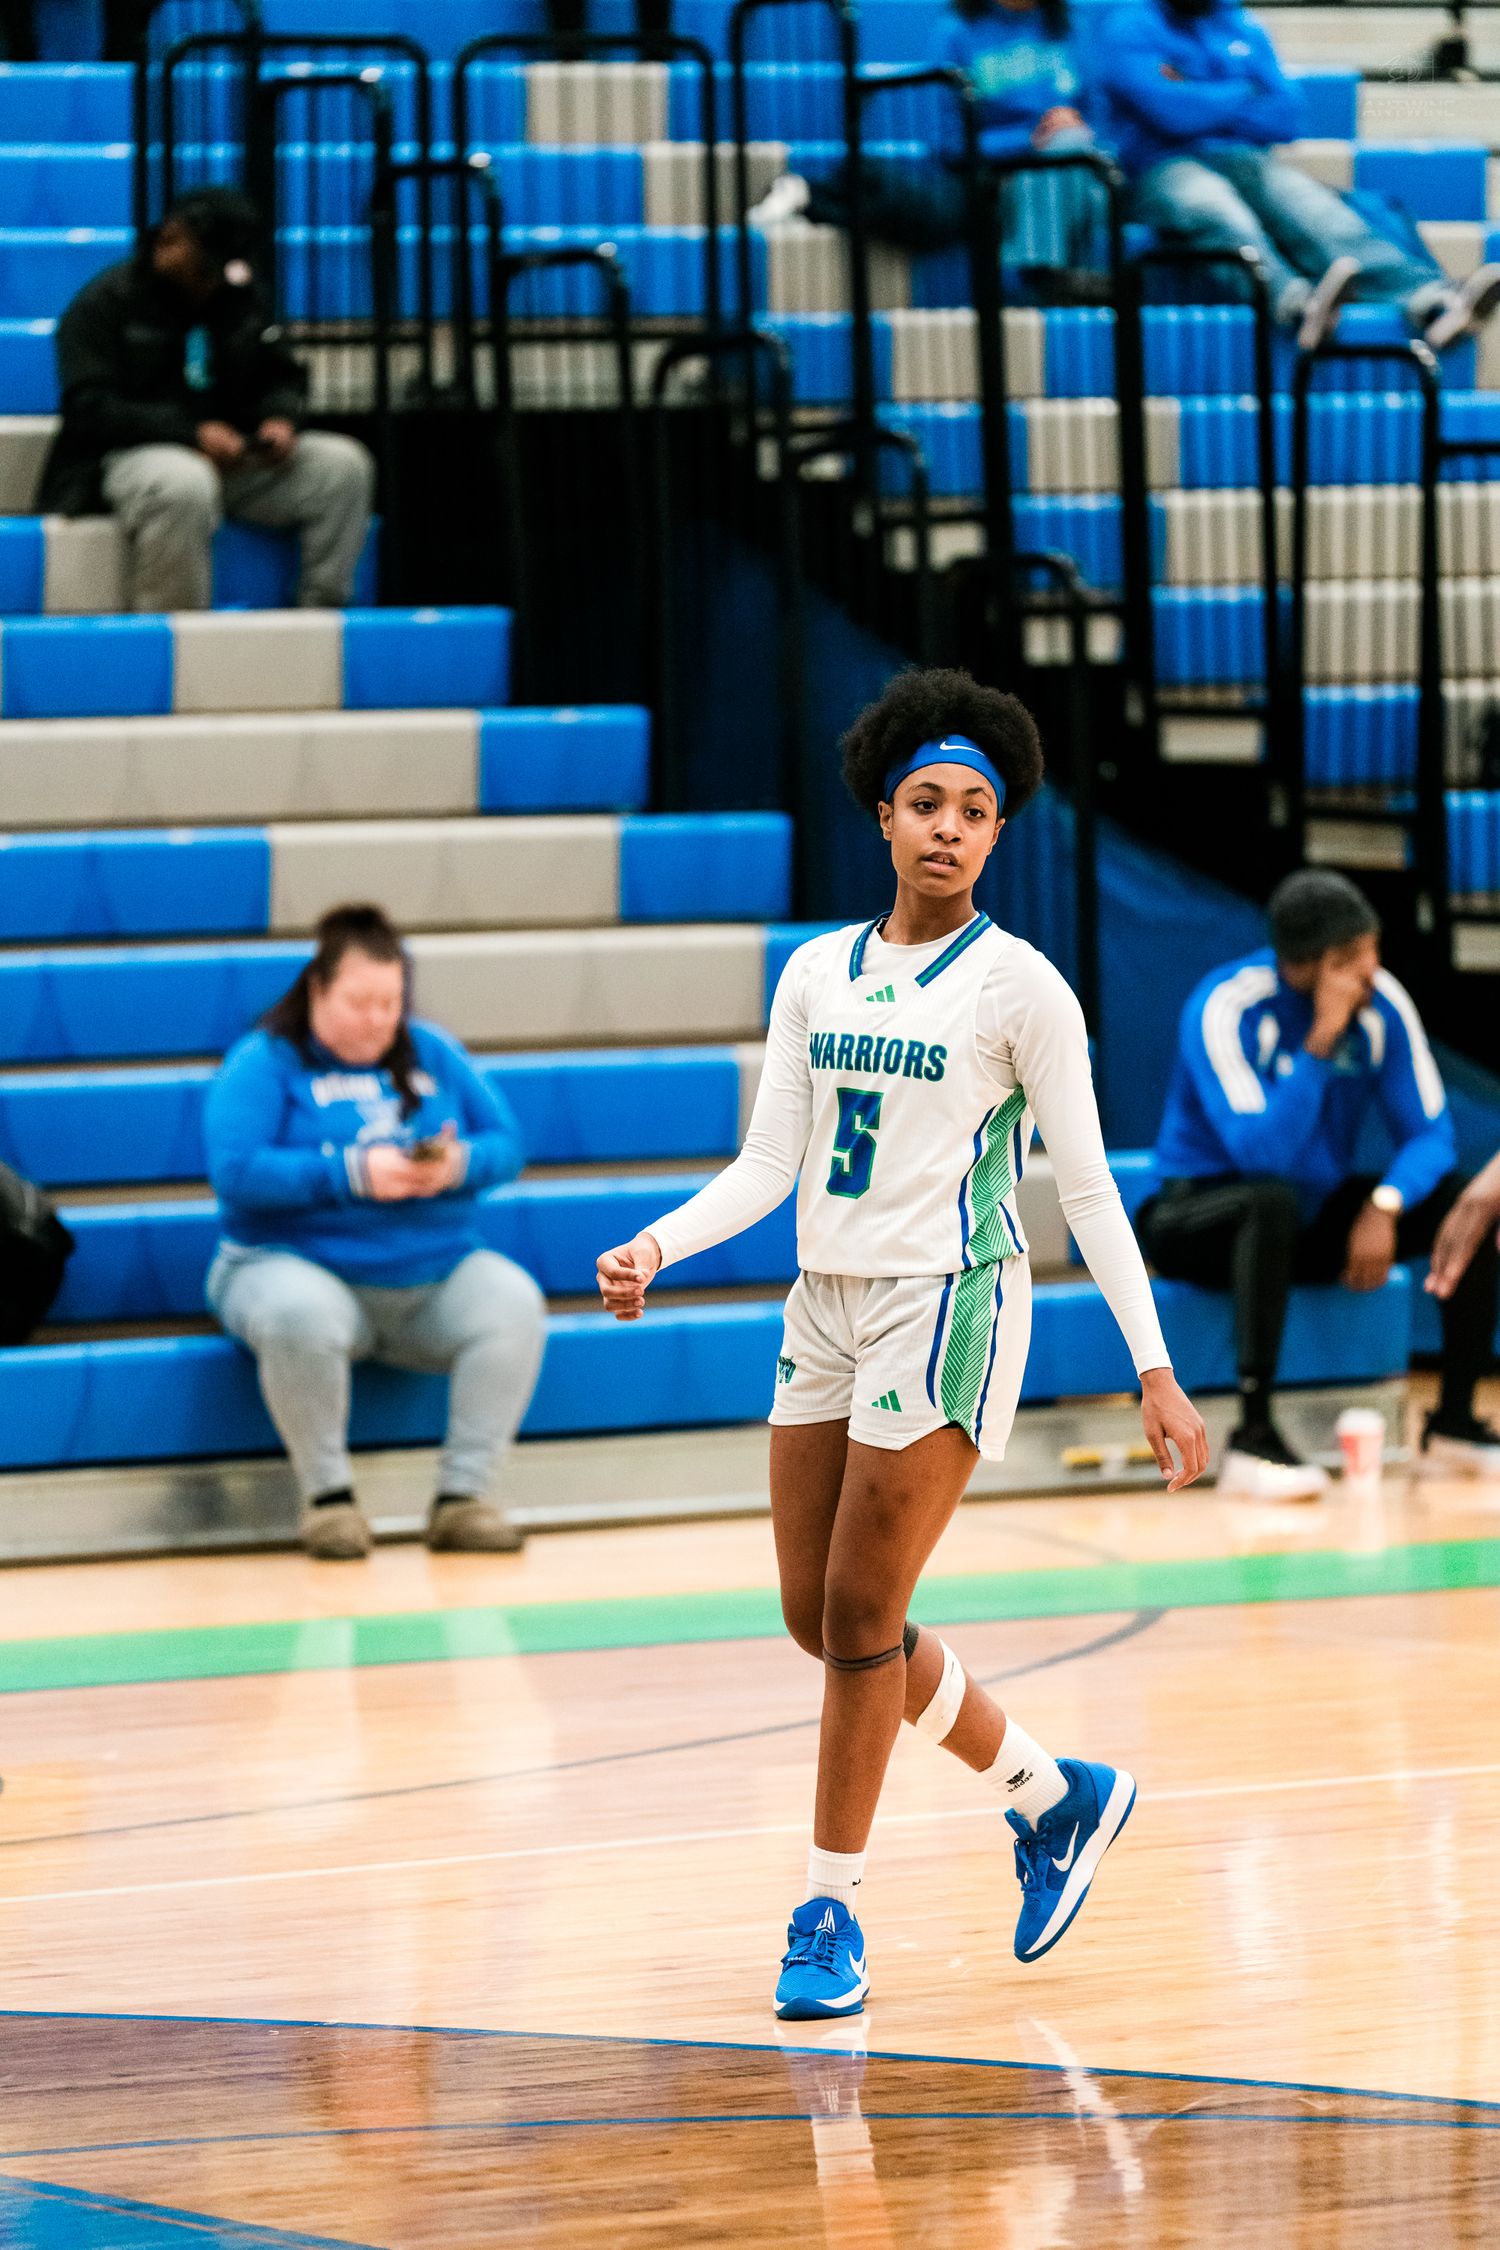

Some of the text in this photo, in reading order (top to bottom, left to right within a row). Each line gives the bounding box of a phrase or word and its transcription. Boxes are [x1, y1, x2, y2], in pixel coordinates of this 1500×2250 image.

[809, 1032, 948, 1082] WARRIORS
[826, 1087, 884, 1200] 5
[1008, 1771, 1034, 1793] adidas
